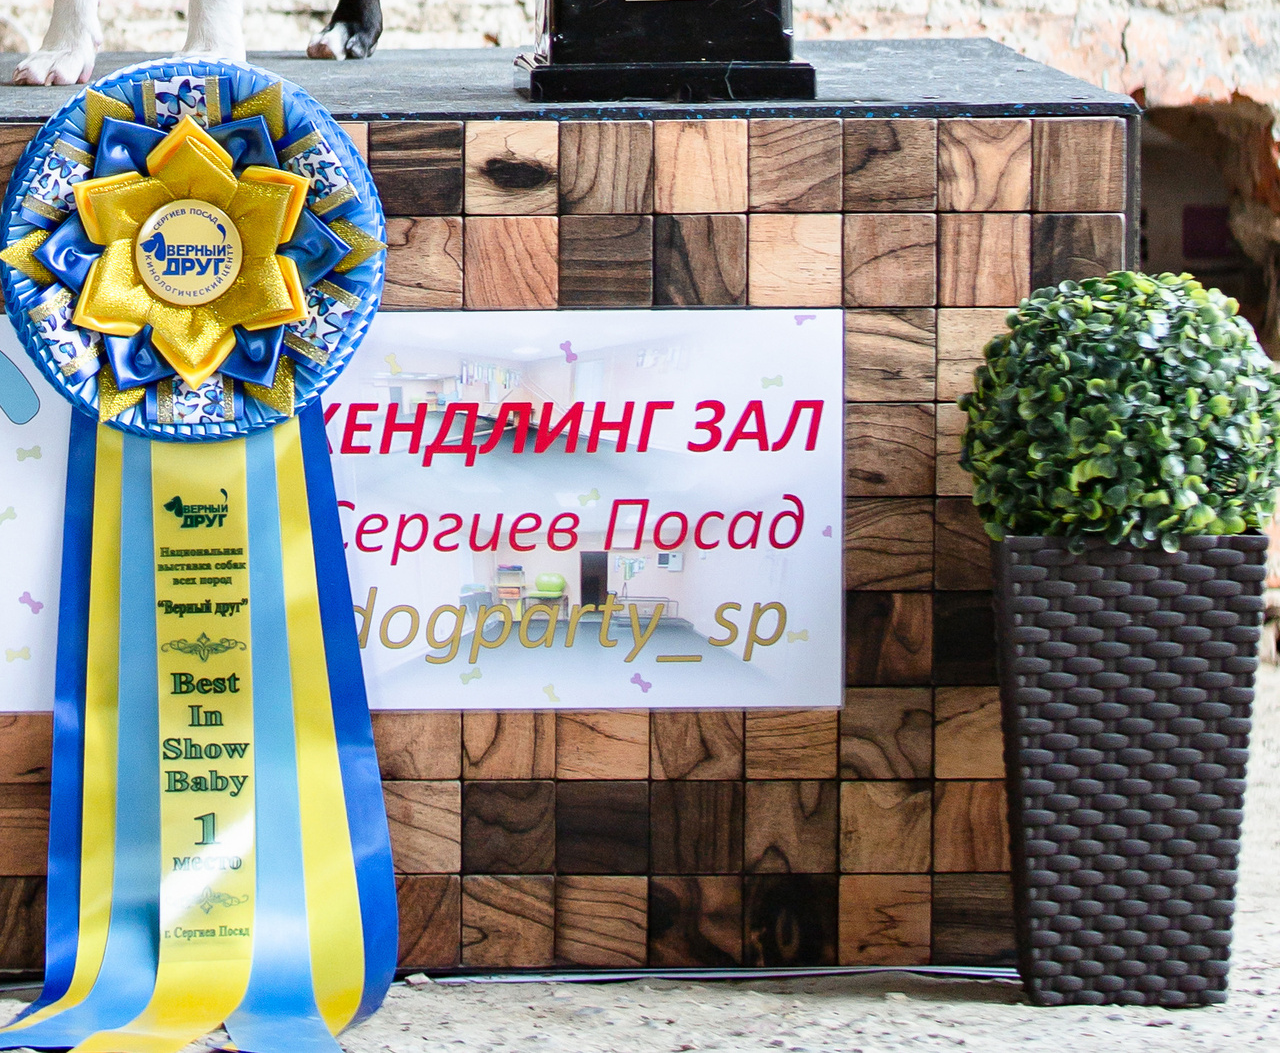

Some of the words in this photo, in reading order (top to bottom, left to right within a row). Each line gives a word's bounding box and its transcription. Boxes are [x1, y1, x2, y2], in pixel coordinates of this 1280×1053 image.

[153, 208, 187, 231] СЕРГИЕВ
[189, 207, 218, 225] ПОСАД
[145, 254, 224, 298] КИНОЛОГИЧЕСКИЙ
[222, 243, 234, 278] ЦЕНТР
[162, 257, 226, 276] ДРУГ
[687, 399, 825, 453] ЗАЛ
[180, 514, 228, 529] ДРУГ
[604, 494, 807, 552] Посад
[159, 546, 244, 558] Национальная
[157, 562, 212, 572] выставка
[214, 559, 247, 571] собак
[172, 576, 197, 586] всех
[199, 575, 233, 588] пород
[353, 587, 788, 665] dogparty_sp
[170, 672, 240, 695] Best
[187, 704, 224, 727] In
[162, 738, 250, 760] Show
[164, 770, 249, 797] Baby
[193, 812, 220, 846] 1
[172, 855, 242, 871] место
[173, 926, 216, 941] Сергиев
[218, 925, 250, 937] Посад
